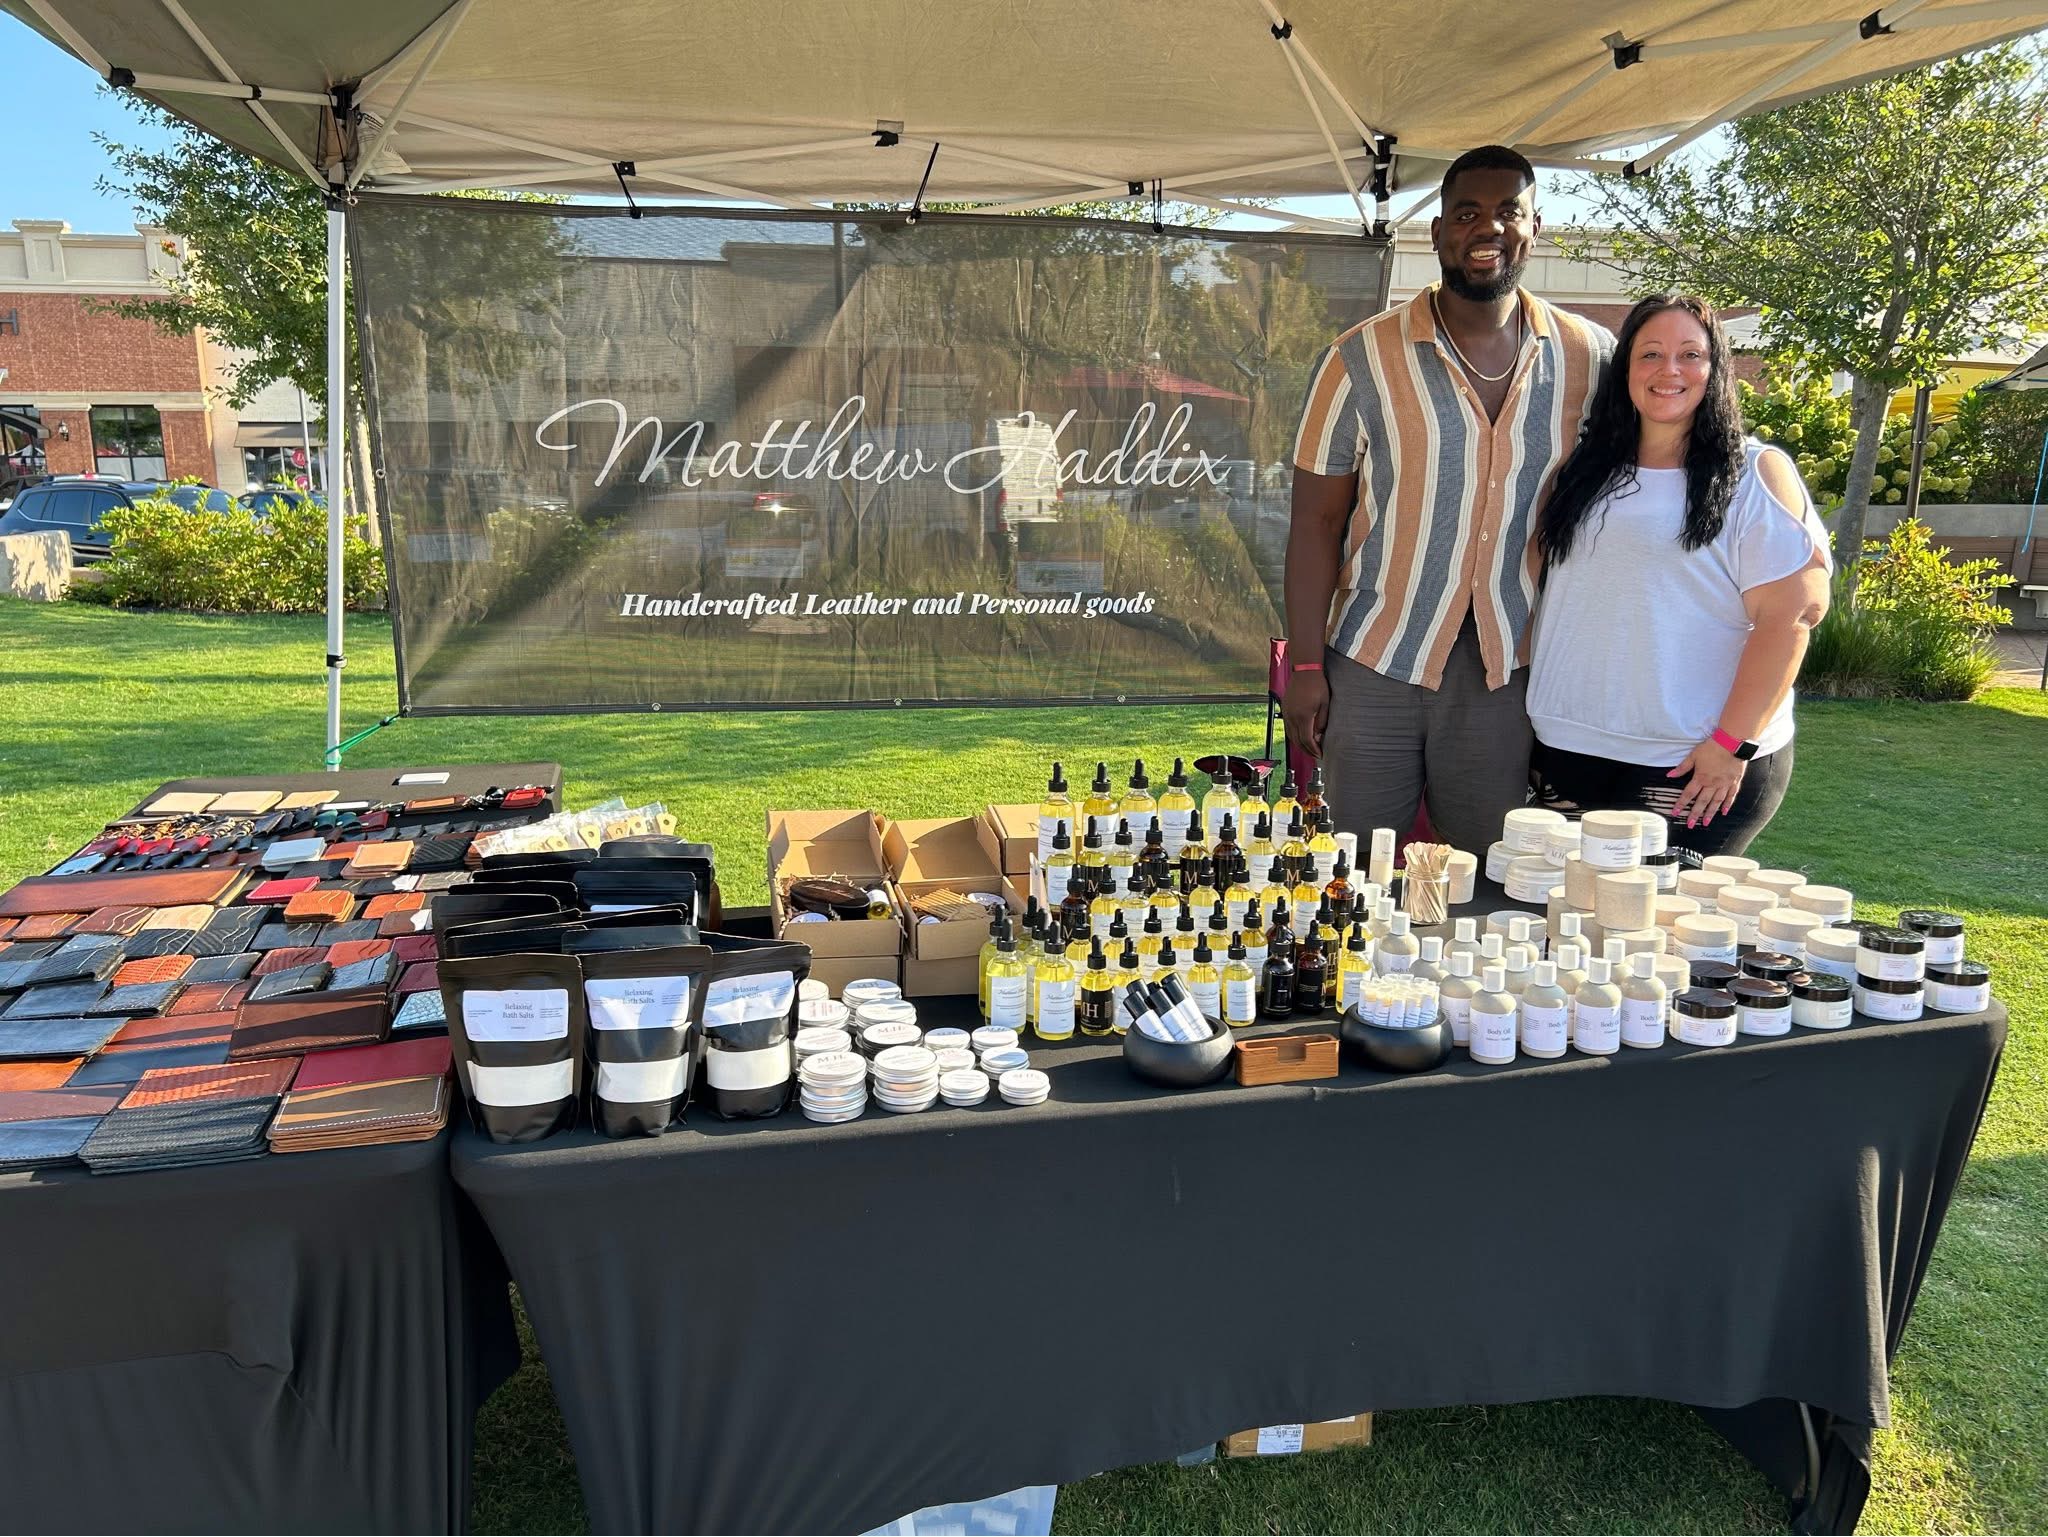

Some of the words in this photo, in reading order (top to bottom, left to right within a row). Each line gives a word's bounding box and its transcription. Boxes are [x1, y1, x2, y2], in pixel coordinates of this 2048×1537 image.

[535, 395, 937, 487] Matthew
[943, 401, 1232, 494] Haddix
[619, 592, 799, 619] Handcrafted
[803, 592, 907, 615] Leather
[912, 591, 965, 615] and
[967, 591, 1082, 615] Personal
[1082, 591, 1156, 619] goods
[1183, 870, 1198, 885] M
[1286, 868, 1300, 882] M
[624, 989, 654, 997] Relaxing
[639, 996, 655, 1004] Salts
[504, 1002, 533, 1011] Relaxing
[502, 1011, 518, 1019] Bath
[519, 1011, 536, 1019] Salts
[1487, 1028, 1502, 1036] Body
